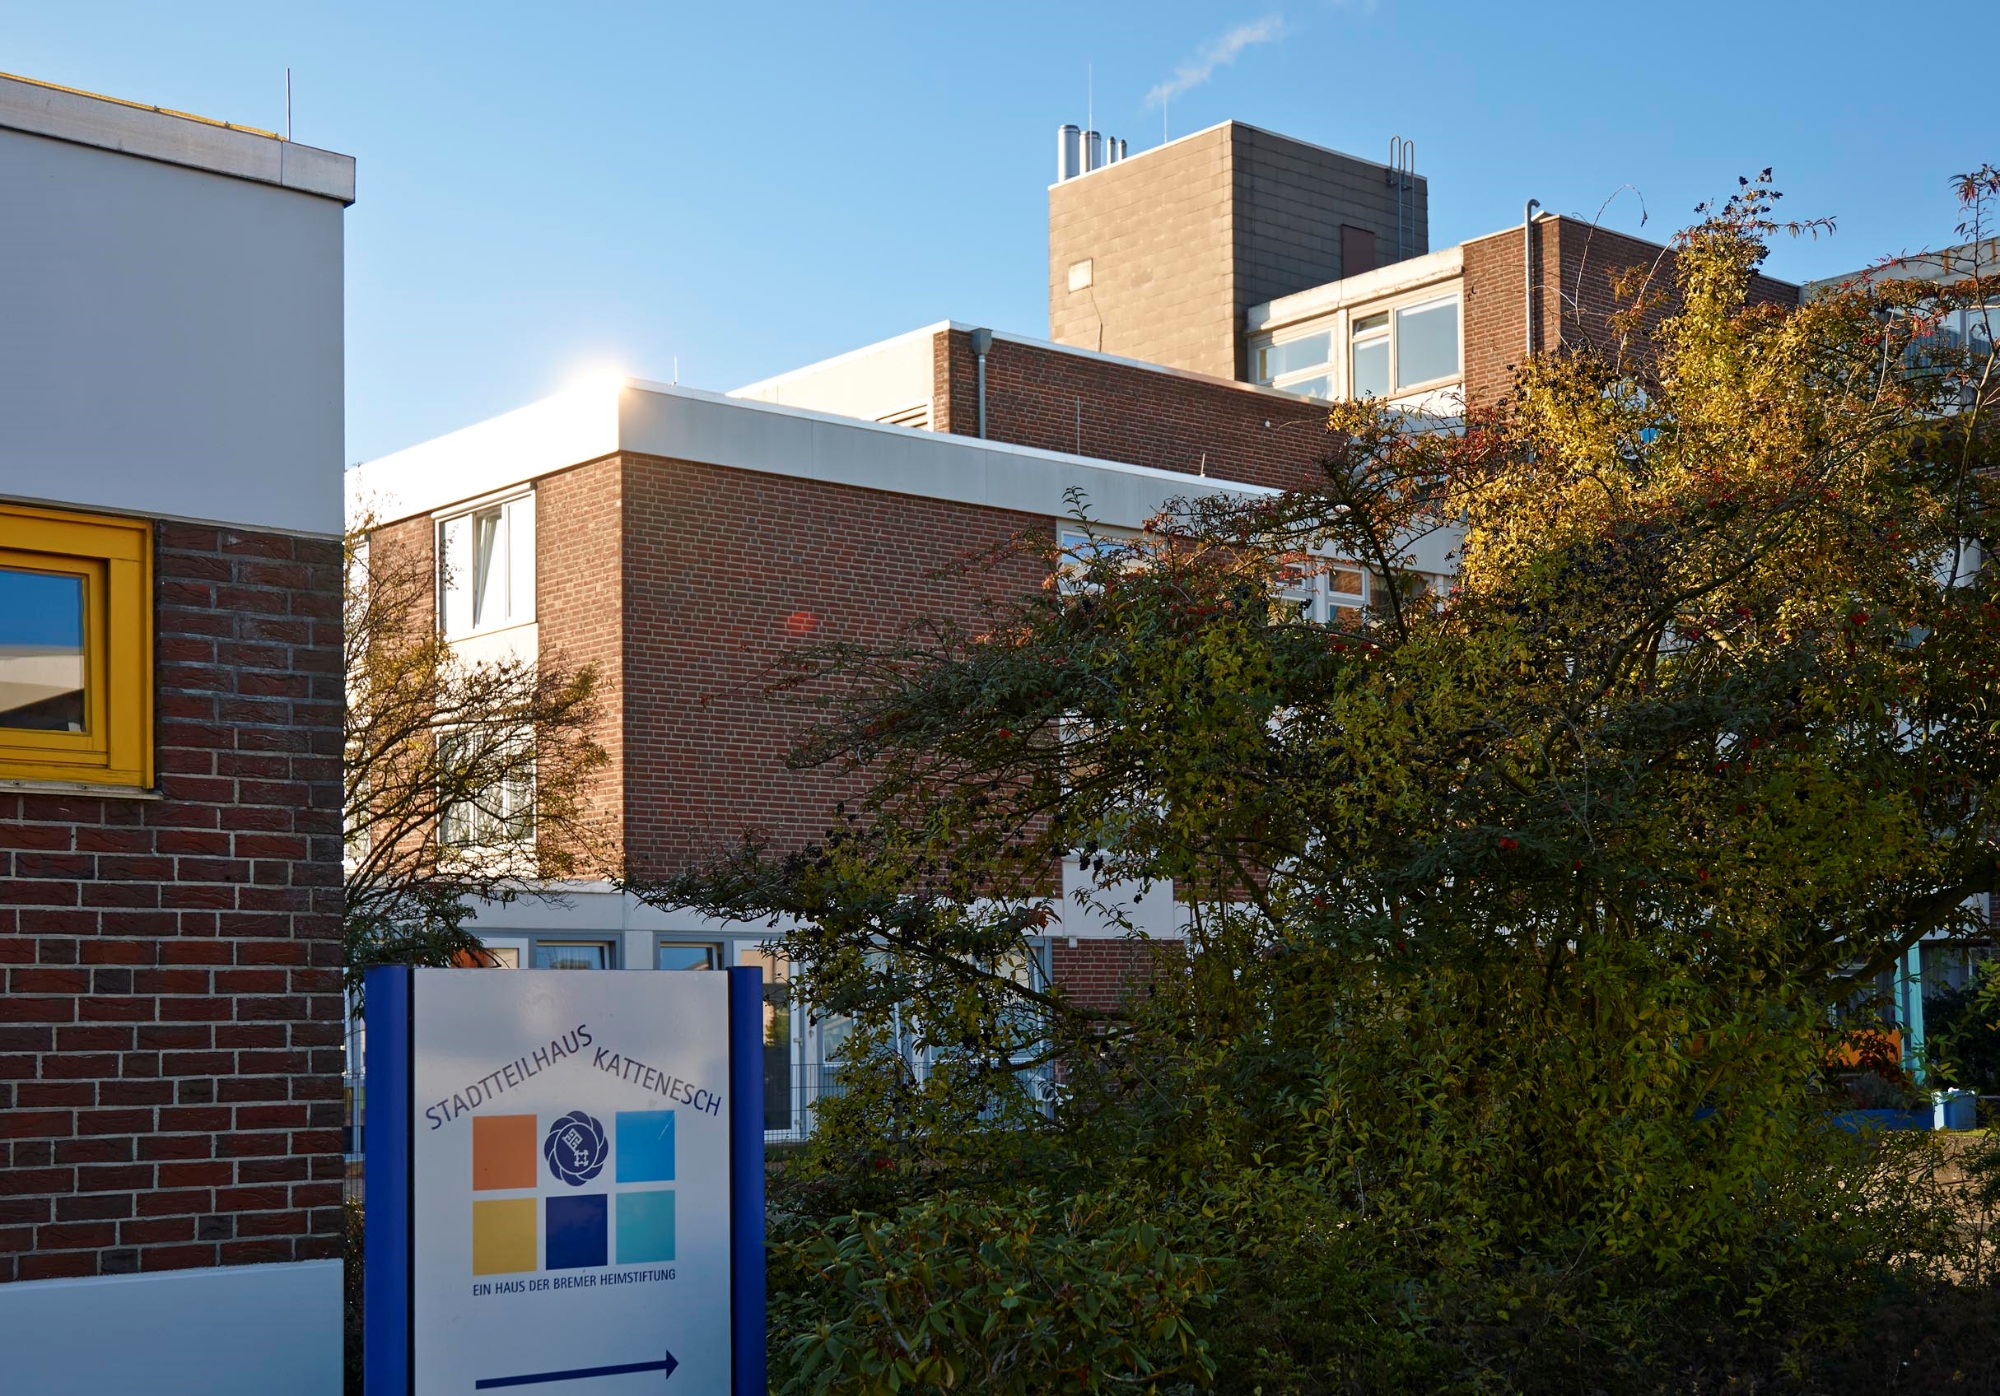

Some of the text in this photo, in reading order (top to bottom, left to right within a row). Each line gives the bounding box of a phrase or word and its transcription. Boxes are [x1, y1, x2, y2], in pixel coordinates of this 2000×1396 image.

[425, 1024, 722, 1131] STADTTEILHAUS KATTENESCH
[473, 1268, 676, 1296] EIN HAUS DER BREMER HEIMSTIFTUNG
